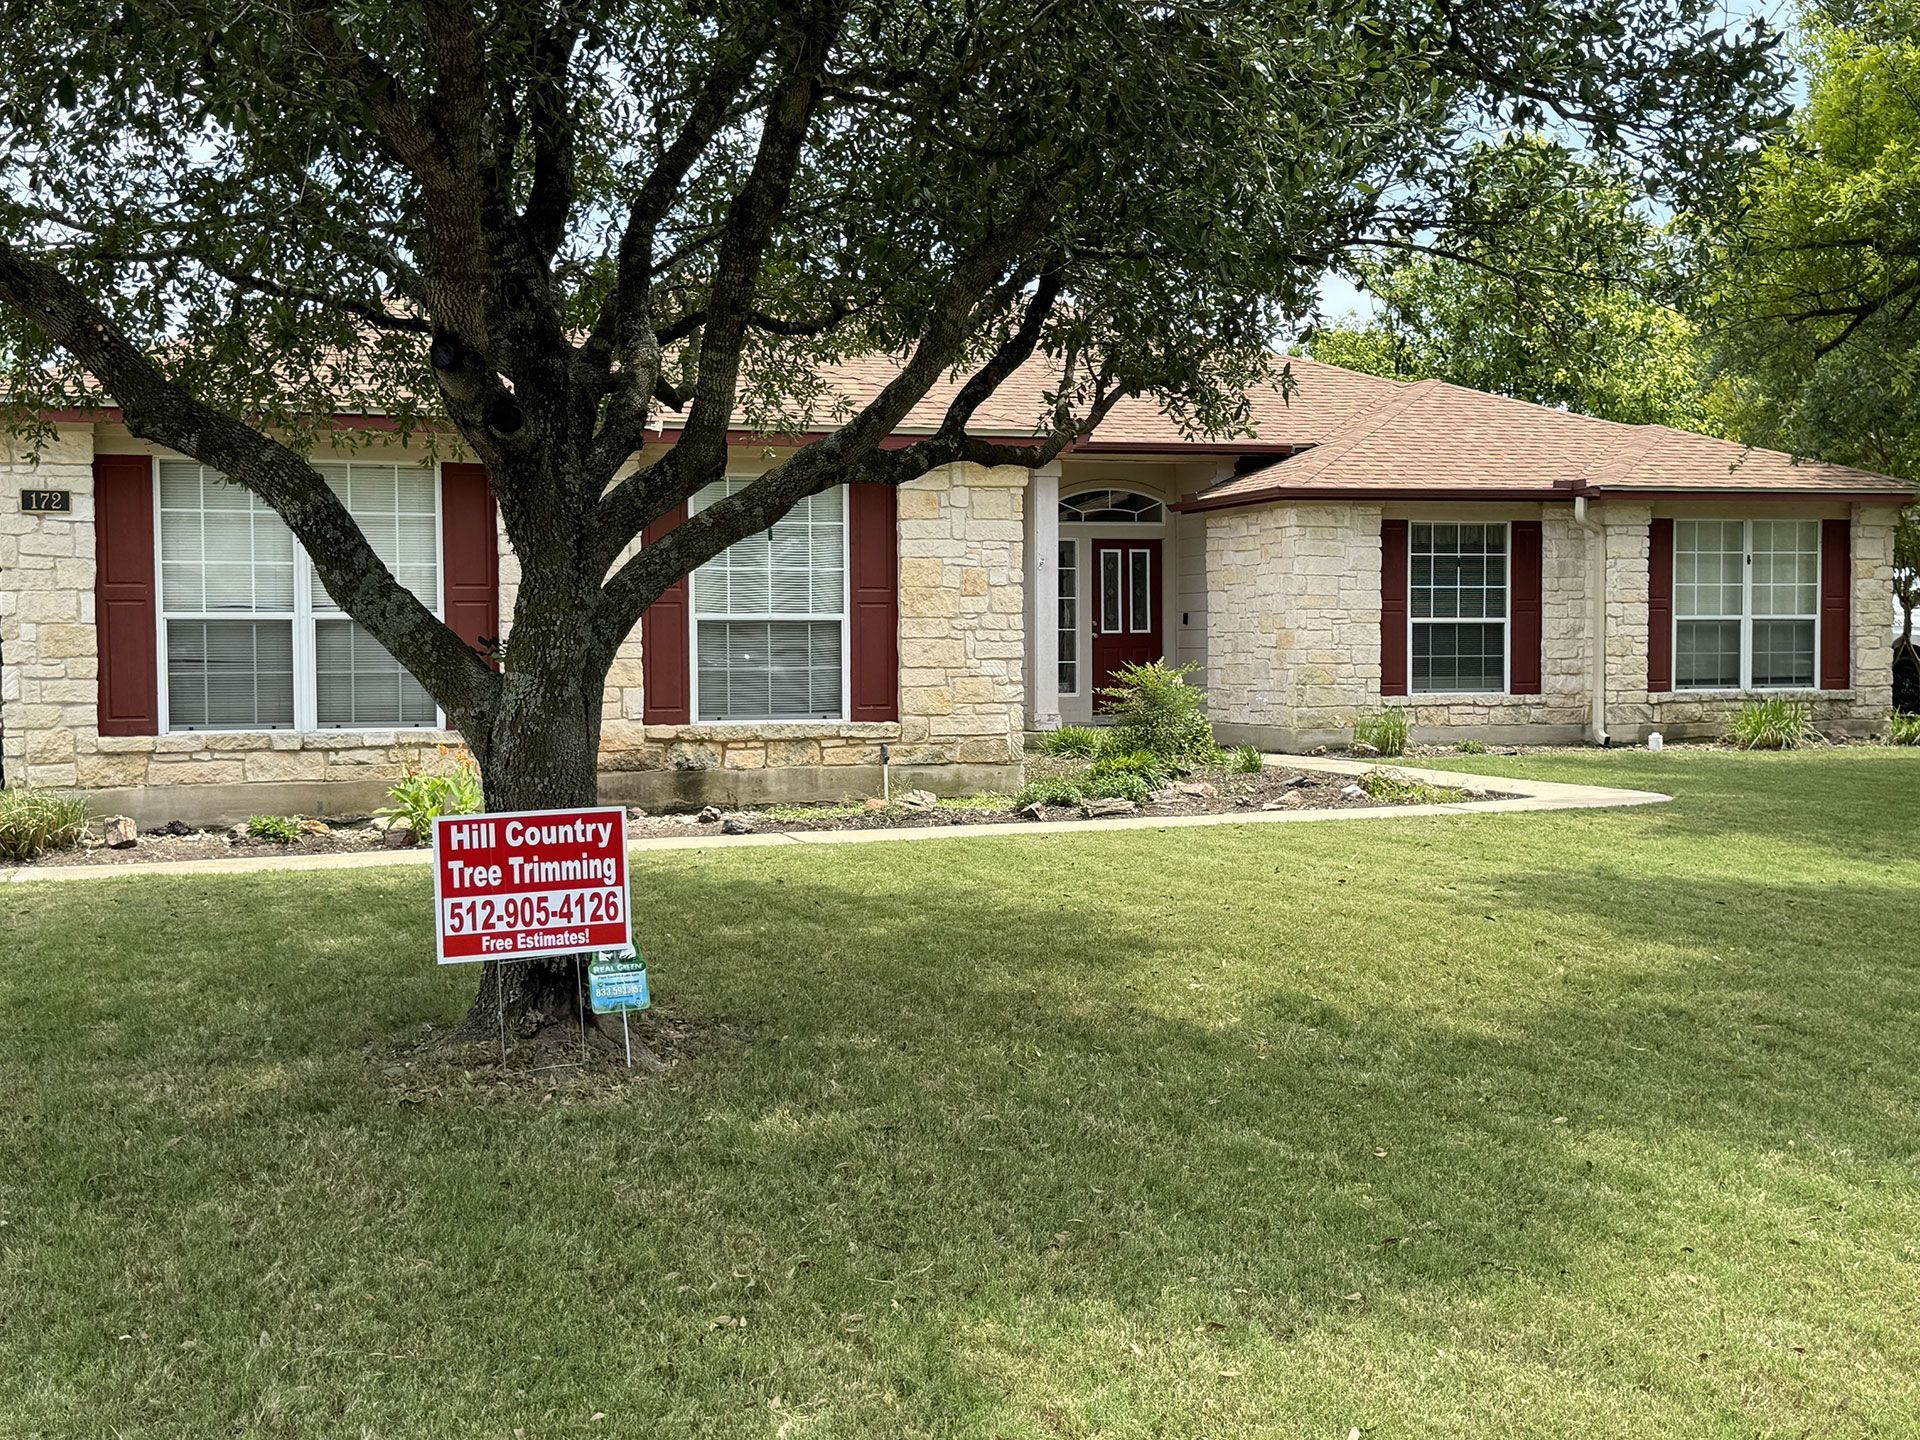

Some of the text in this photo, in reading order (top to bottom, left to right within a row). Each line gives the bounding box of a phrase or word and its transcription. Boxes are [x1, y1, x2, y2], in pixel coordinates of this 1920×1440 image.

[31, 492, 62, 509] 172
[450, 818, 613, 850] Hill Country
[448, 853, 616, 888] Tree Trimming
[450, 891, 619, 933] 512-905-4126
[481, 928, 590, 951] Free Estimates!
[593, 966, 614, 974] REAL
